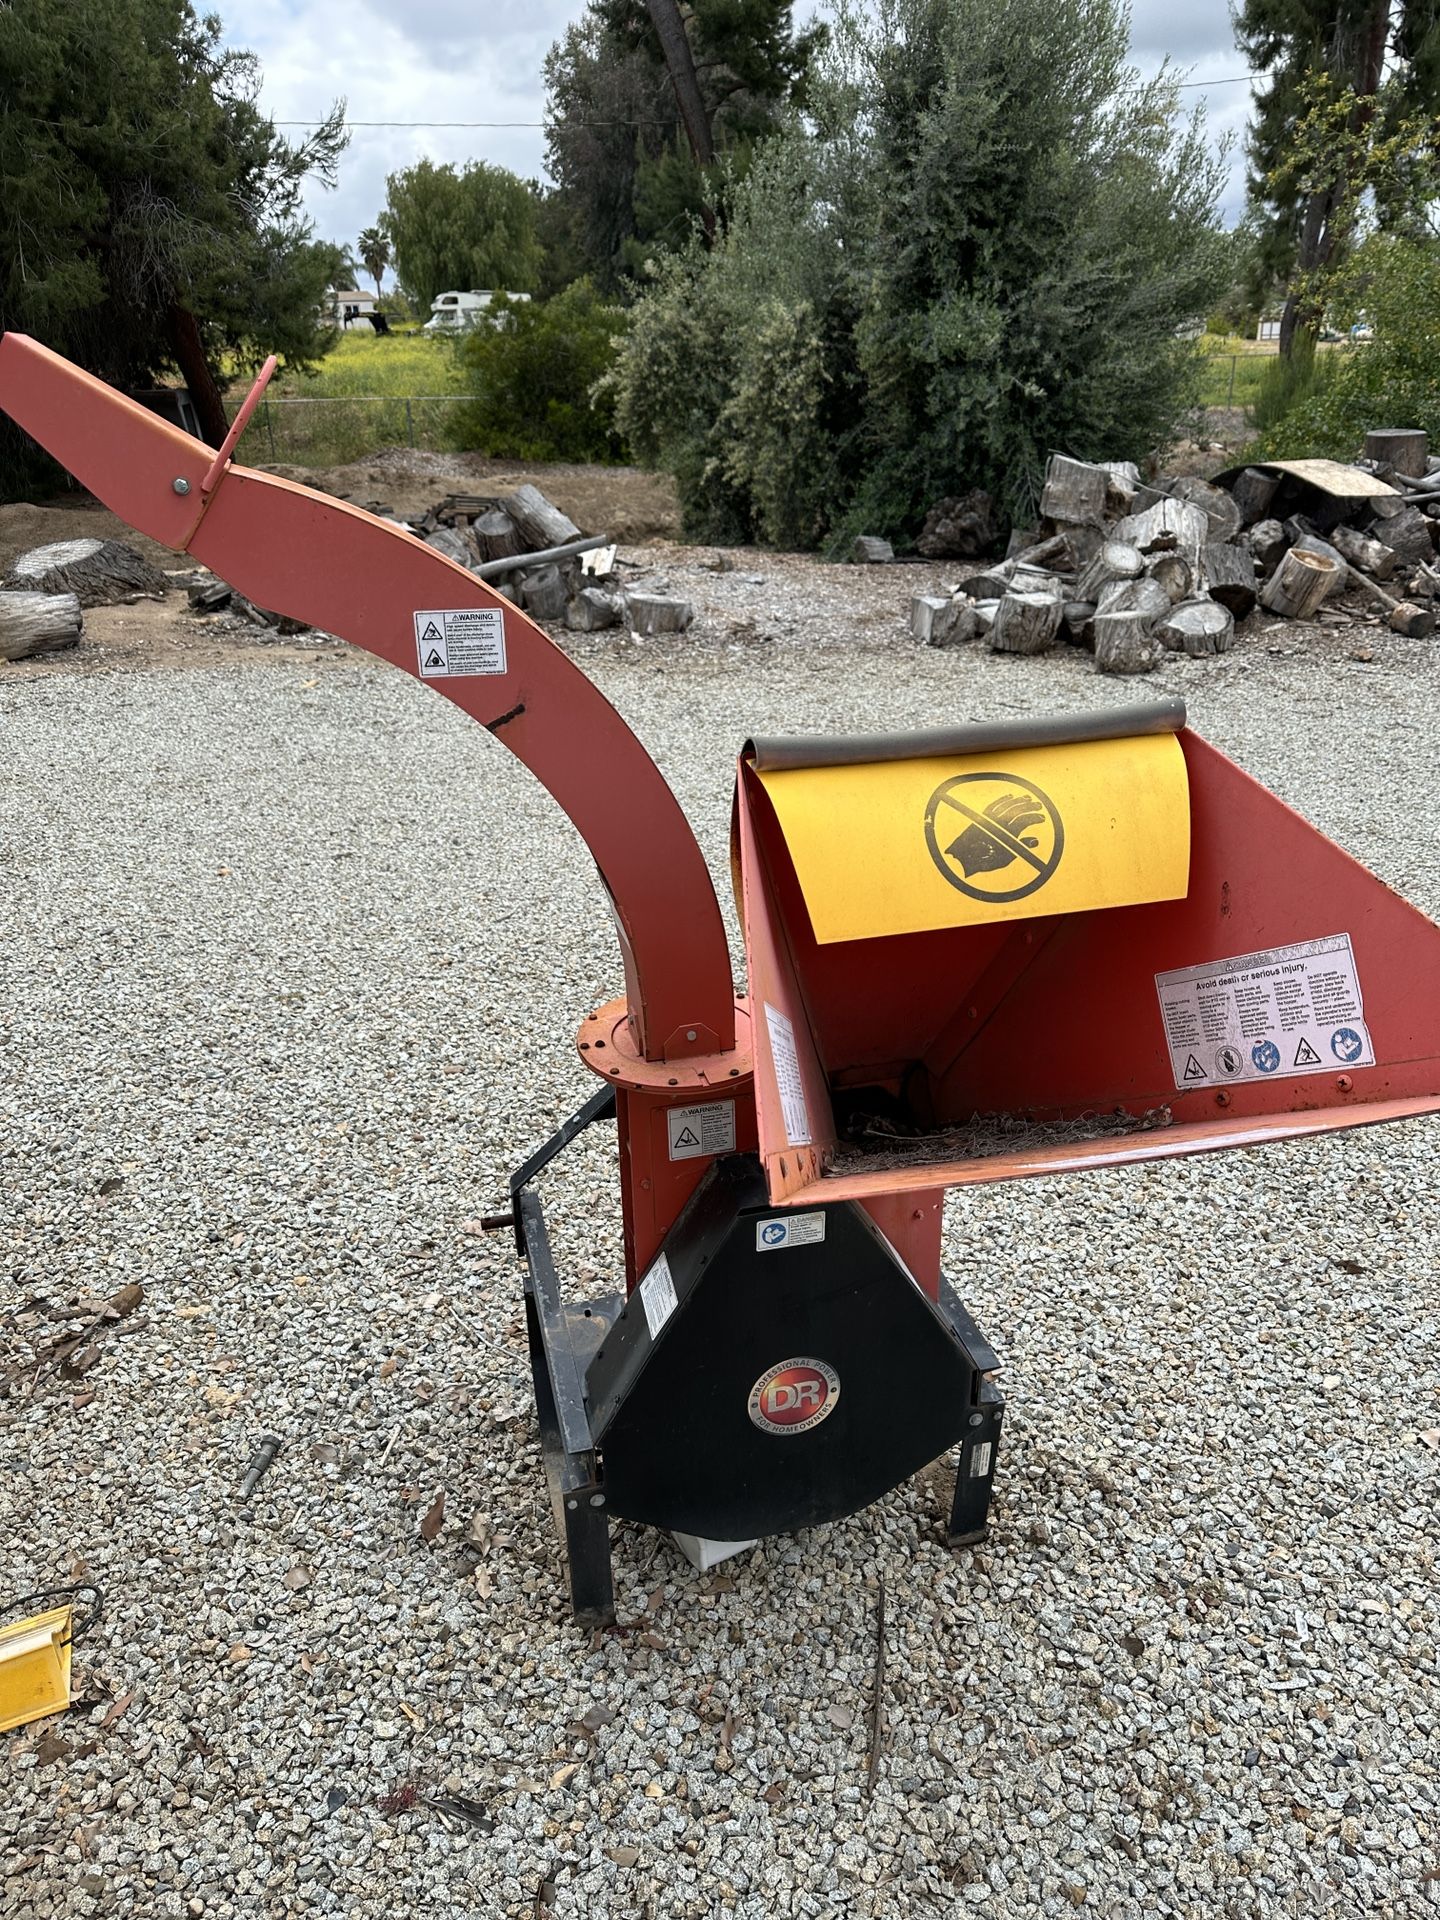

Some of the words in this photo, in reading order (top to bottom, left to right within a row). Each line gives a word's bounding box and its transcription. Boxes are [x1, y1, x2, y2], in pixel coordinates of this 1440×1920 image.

[459, 613, 493, 621] WARNING
[1196, 979, 1217, 991] Avoid
[1218, 975, 1239, 986] death
[1251, 967, 1280, 980] serious
[1282, 962, 1308, 974] injury.
[688, 1105, 723, 1115] WARNING
[753, 1359, 810, 1397] PROFESSIONAL
[814, 1361, 836, 1384] POWER
[767, 1380, 820, 1413] DR
[756, 1416, 770, 1429] FOR
[772, 1403, 832, 1433] HOMEOWNERS
